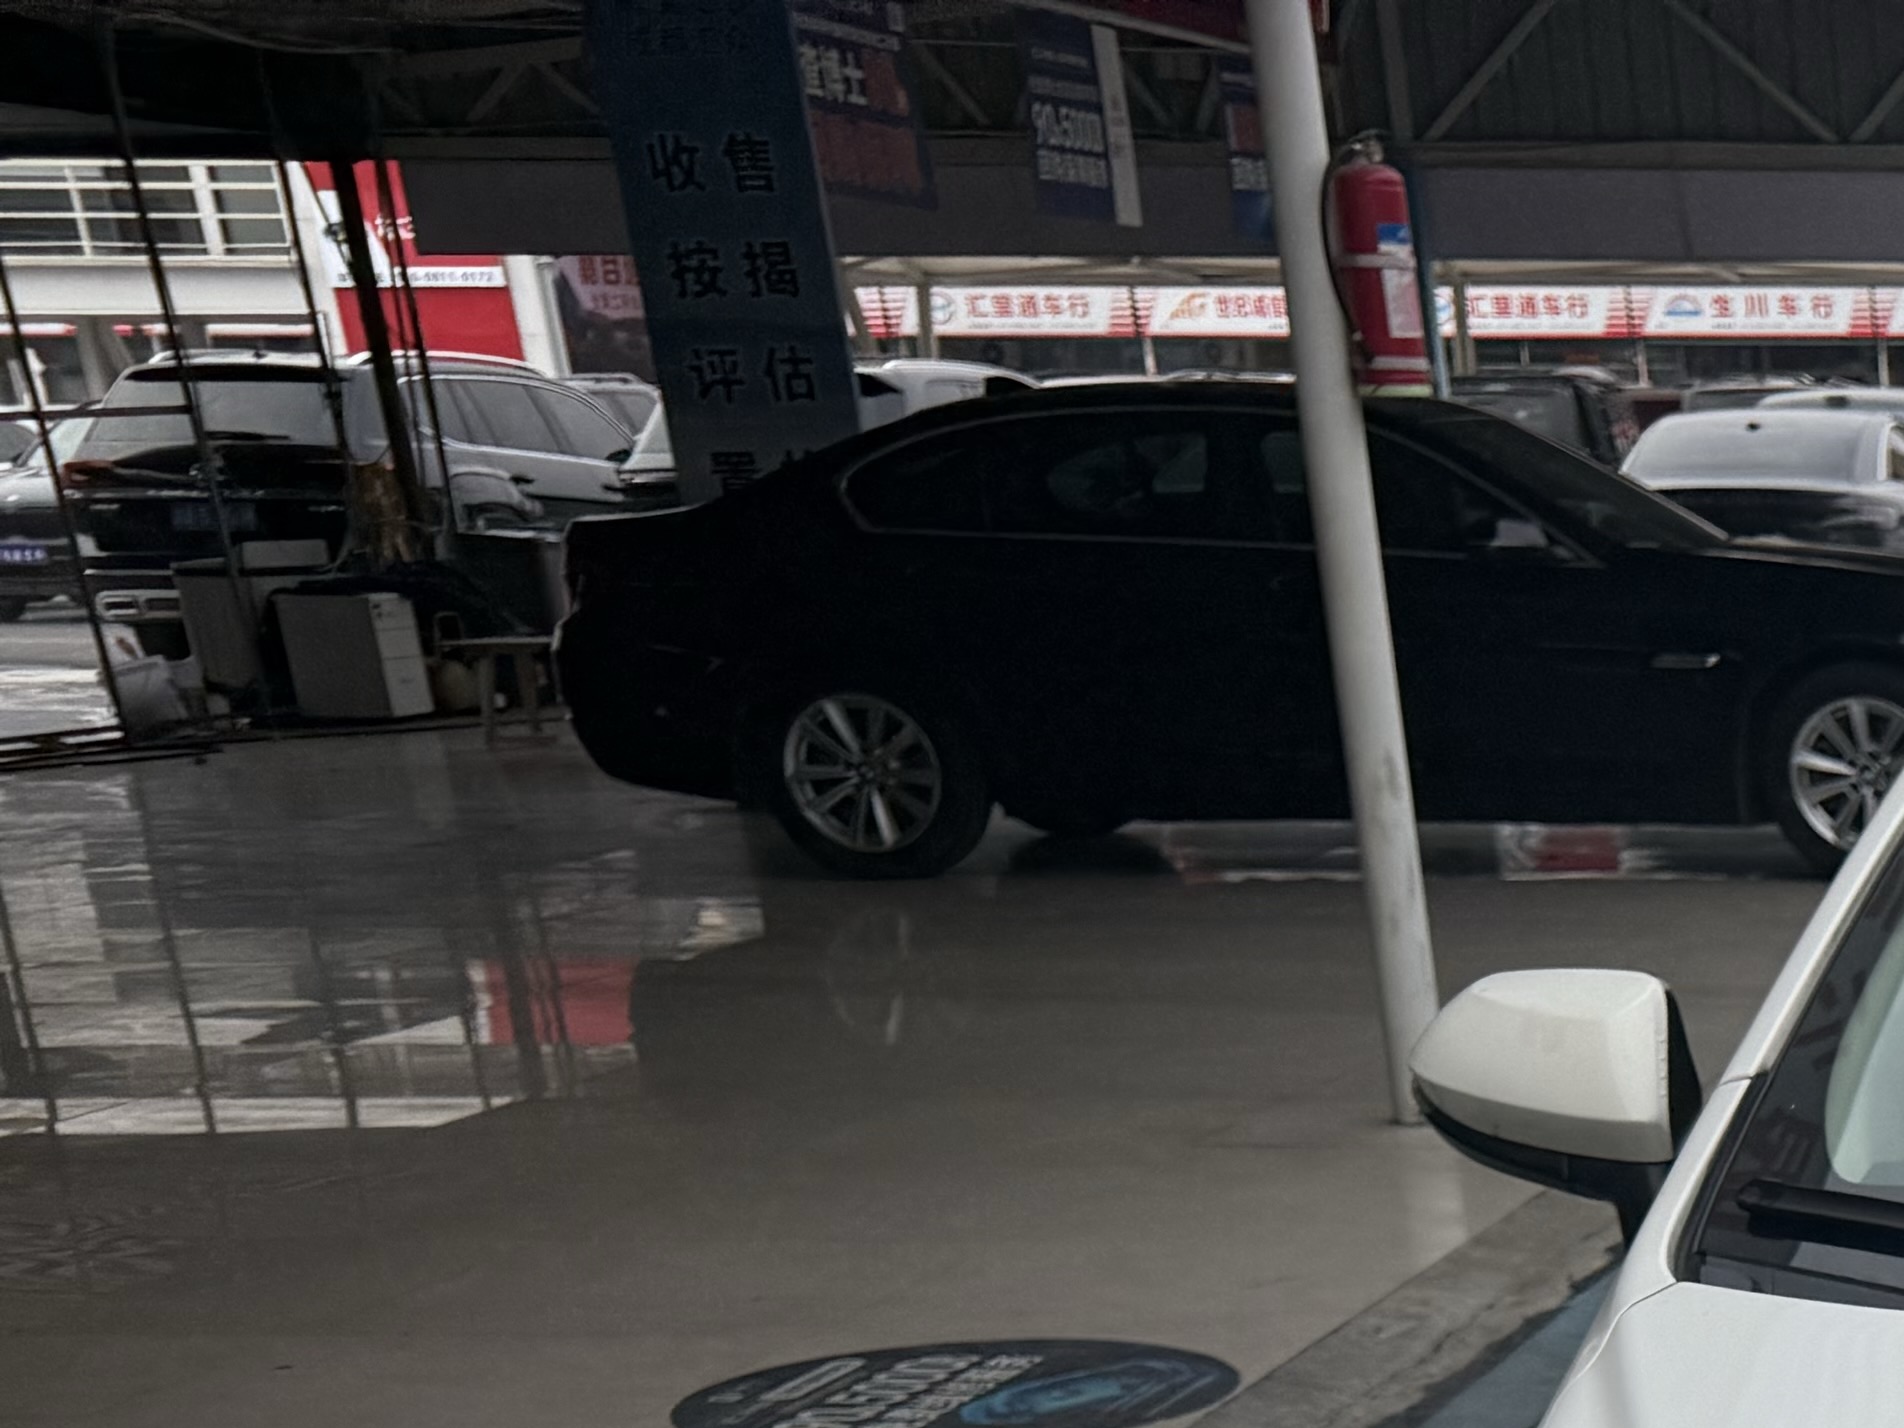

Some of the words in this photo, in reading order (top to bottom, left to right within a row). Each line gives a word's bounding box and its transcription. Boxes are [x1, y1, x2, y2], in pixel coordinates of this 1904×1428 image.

[647, 133, 775, 193] 收售
[668, 241, 802, 298] 按揭
[689, 346, 818, 403] 评估
